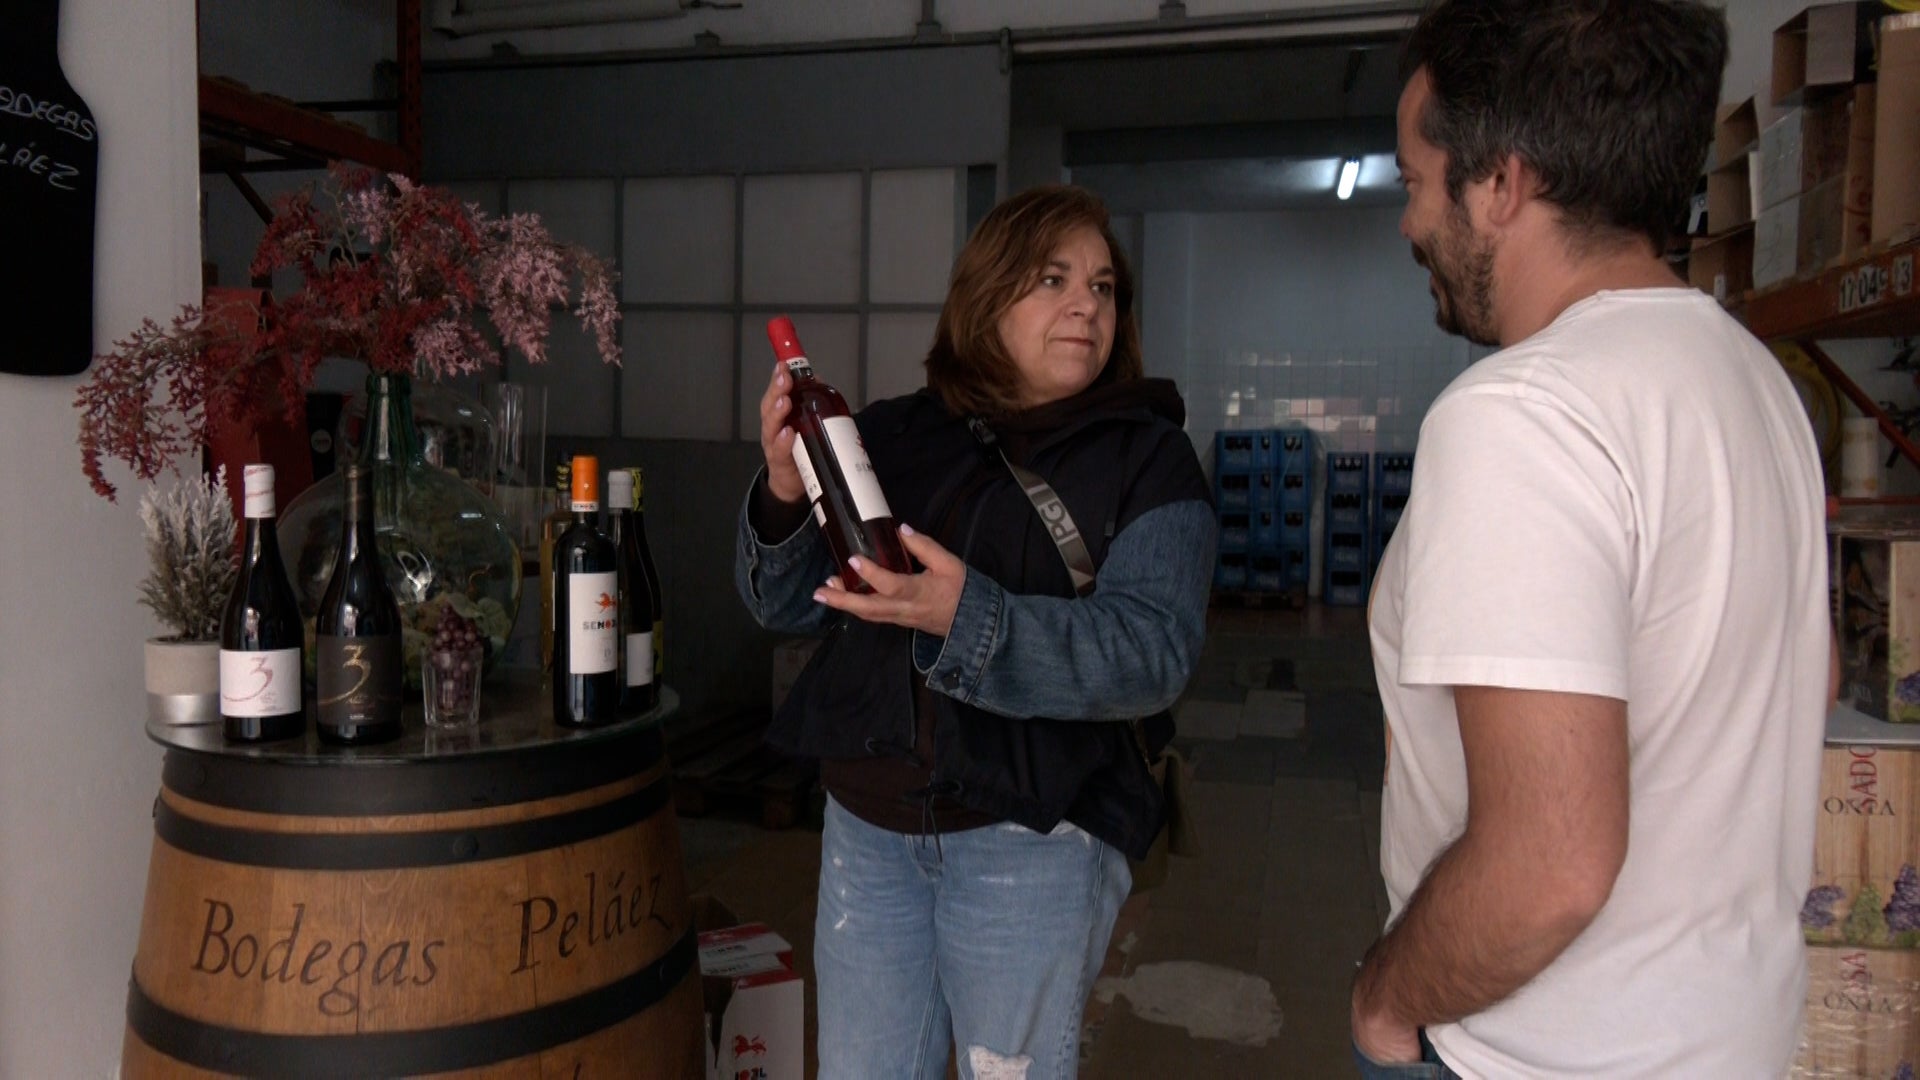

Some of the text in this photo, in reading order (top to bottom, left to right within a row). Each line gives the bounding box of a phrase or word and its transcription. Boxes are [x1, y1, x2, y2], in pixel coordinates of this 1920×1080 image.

[331, 645, 371, 702] 3
[190, 871, 671, 1017] Bodegas Peláez
